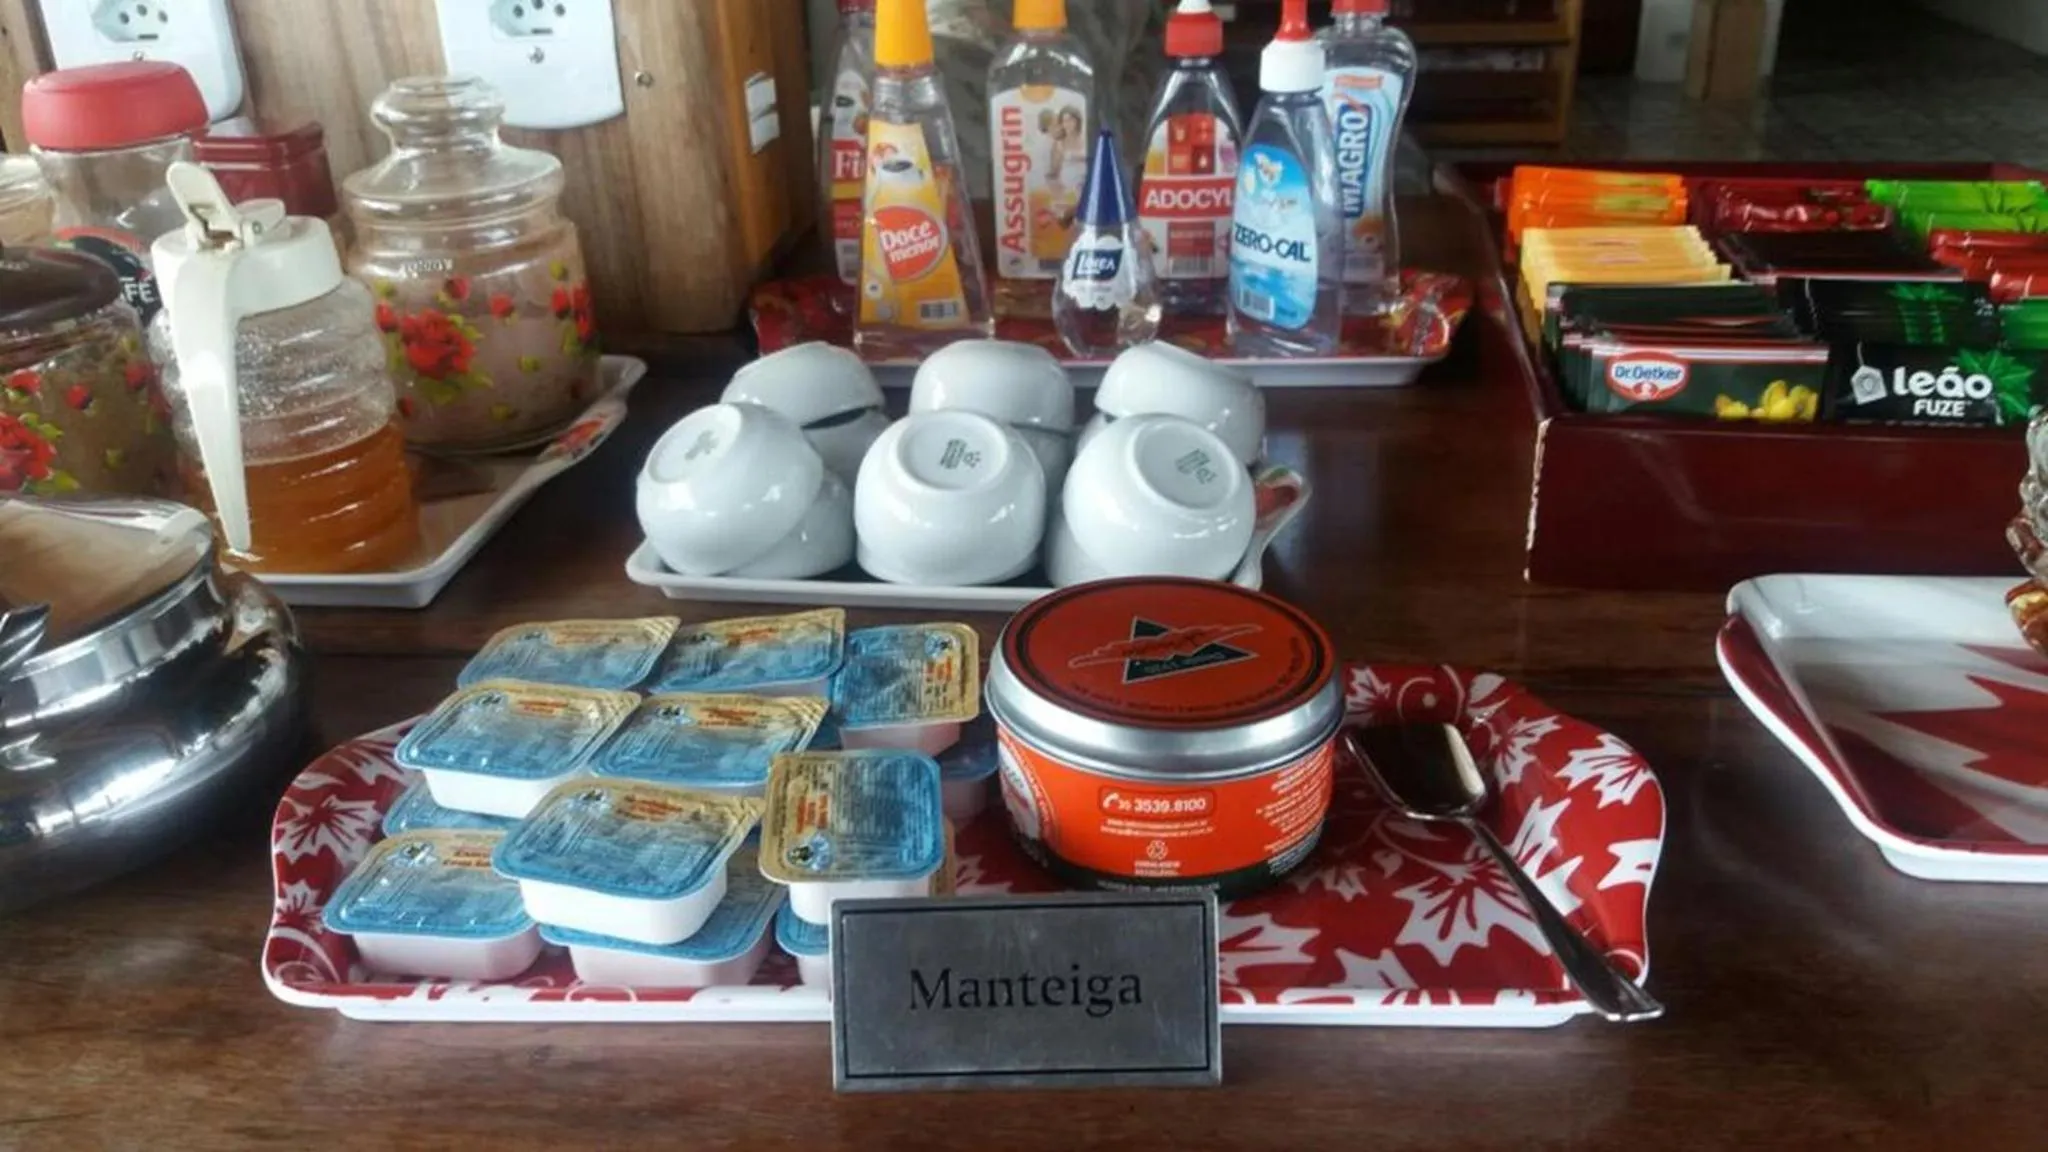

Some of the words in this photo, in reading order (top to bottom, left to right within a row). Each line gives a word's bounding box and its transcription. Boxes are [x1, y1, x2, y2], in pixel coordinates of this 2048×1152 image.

[1001, 106, 1031, 253] Assugrin
[1893, 366, 1993, 400] leão
[1913, 399, 1966, 418] FUZE
[909, 964, 1144, 1018] Manteiga
